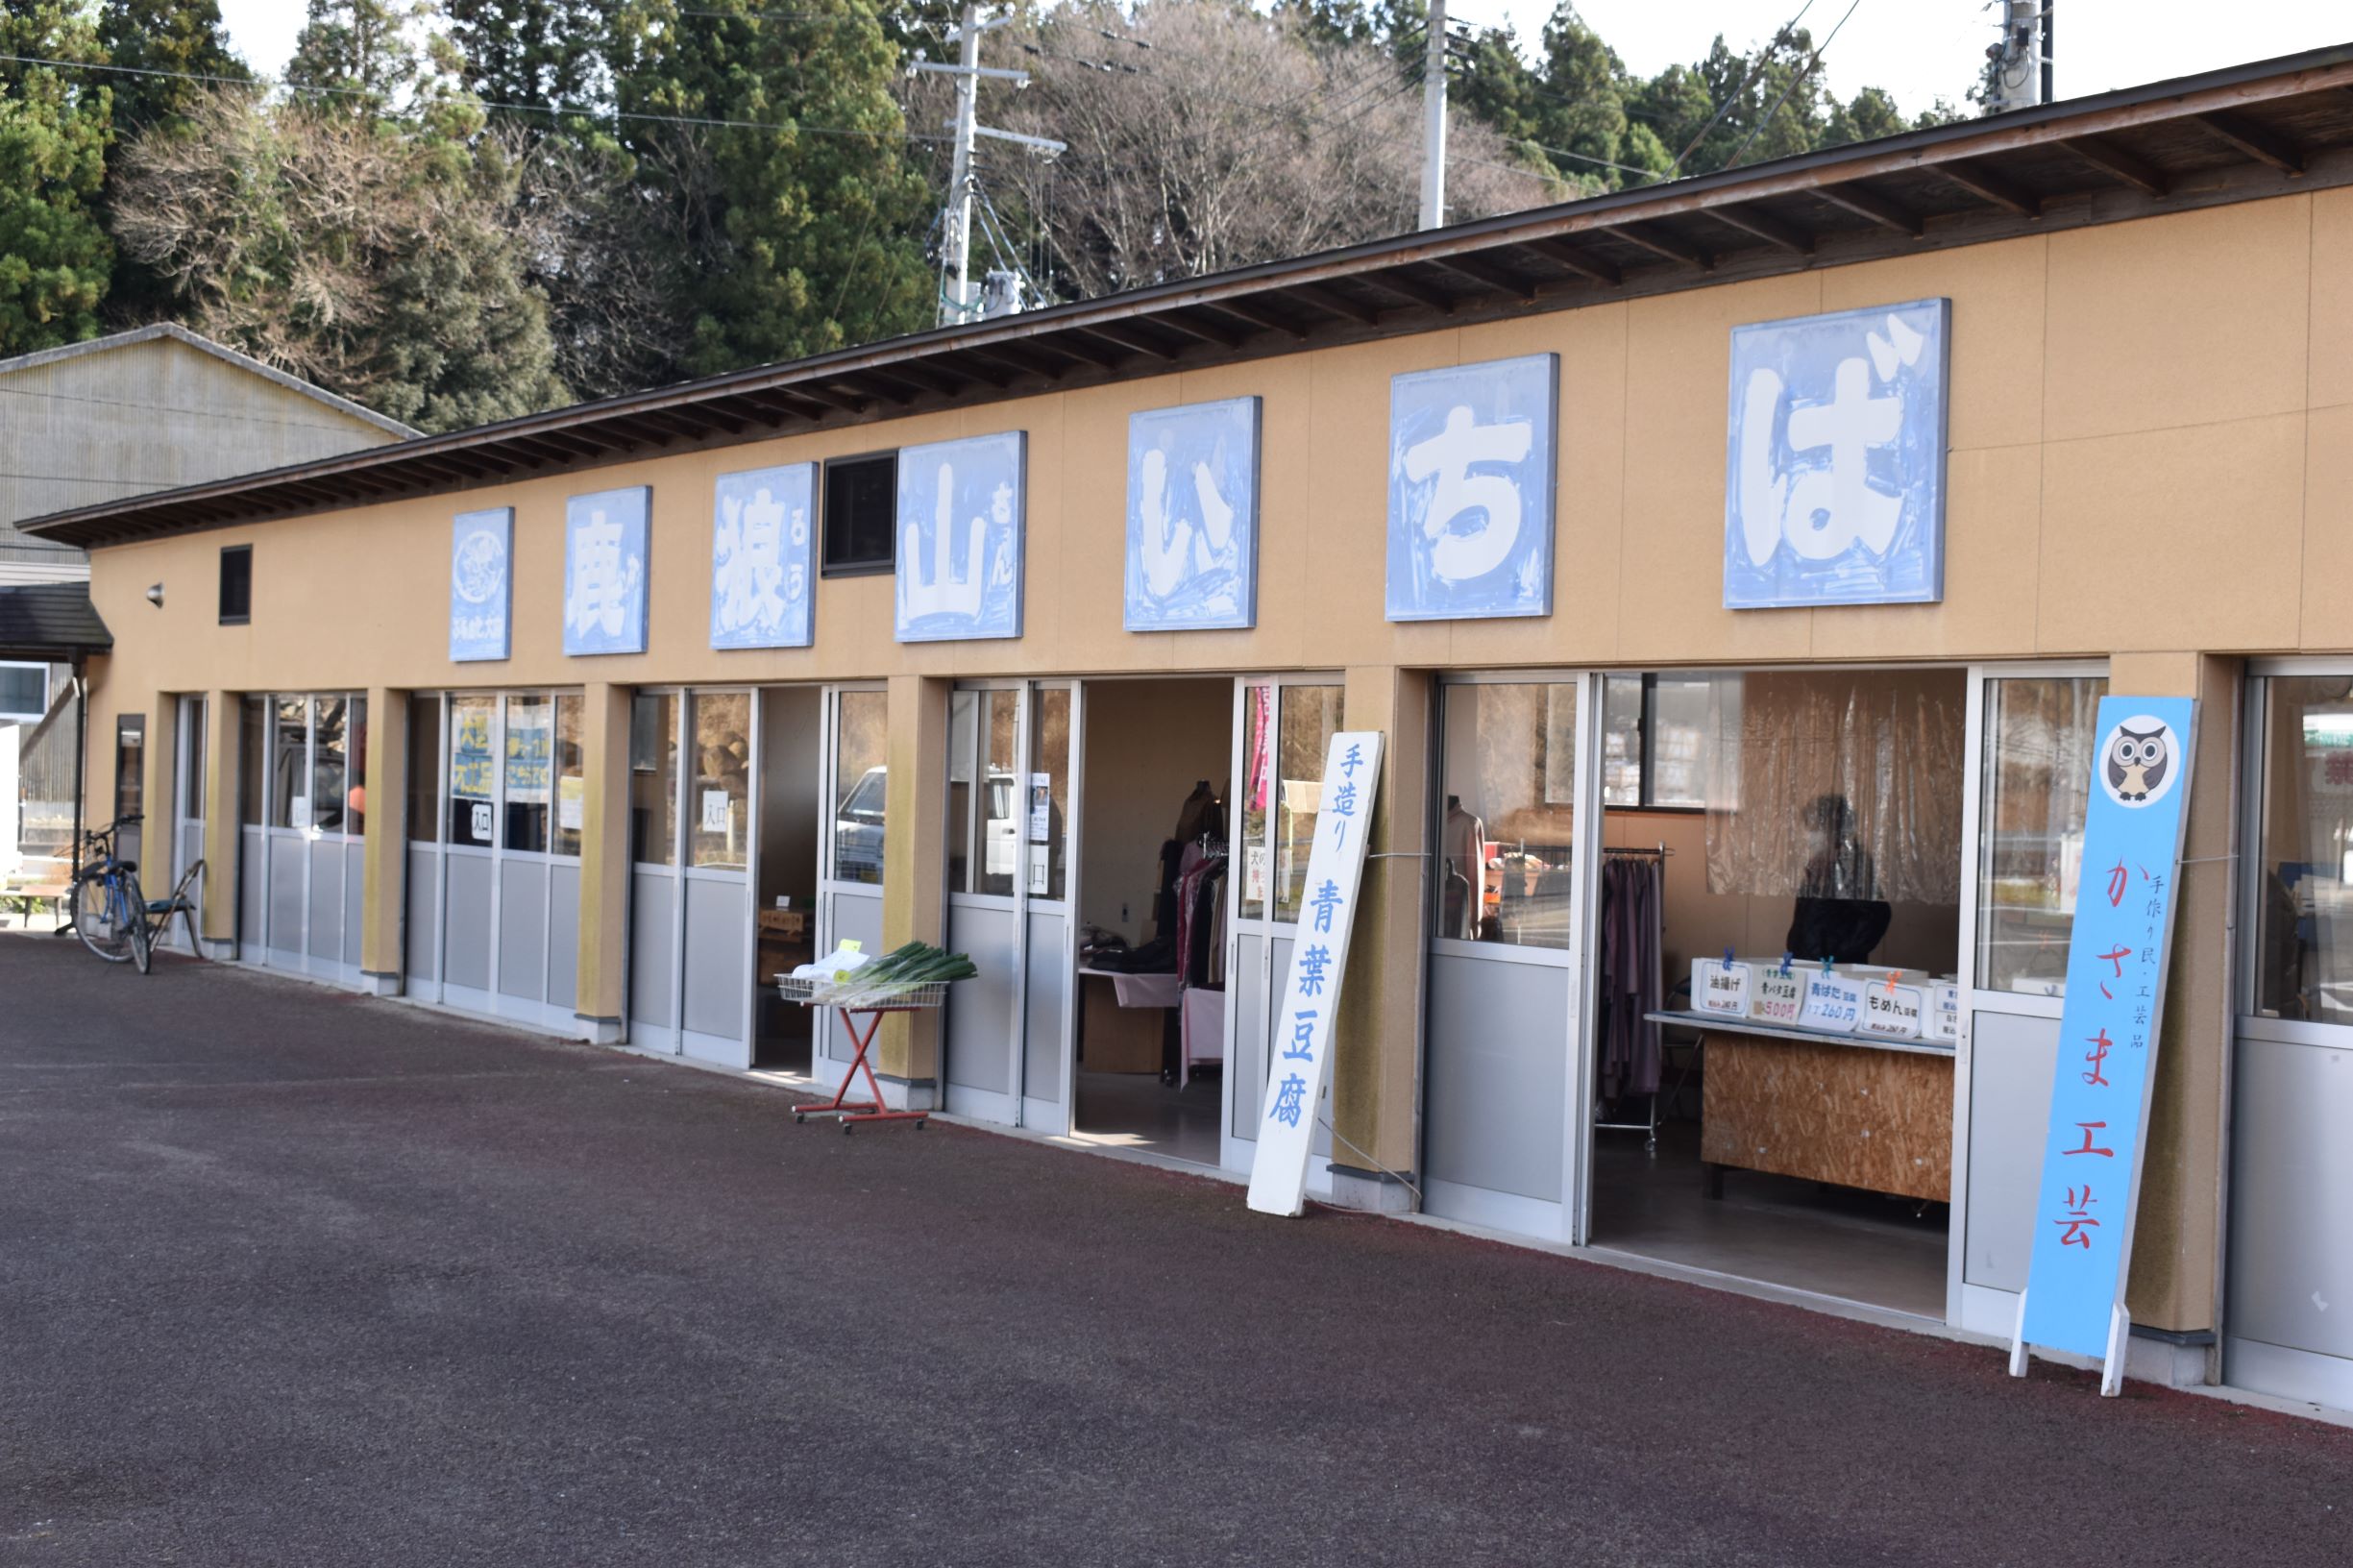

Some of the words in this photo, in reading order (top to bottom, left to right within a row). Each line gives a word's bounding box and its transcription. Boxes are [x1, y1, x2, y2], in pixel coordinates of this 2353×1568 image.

[473, 811, 491, 832] 入口
[704, 803, 726, 826] 入口
[1332, 743, 1364, 853] 手造り
[1267, 878, 1344, 1129] 青葉豆腐
[2052, 855, 2149, 1250] かさま工芸
